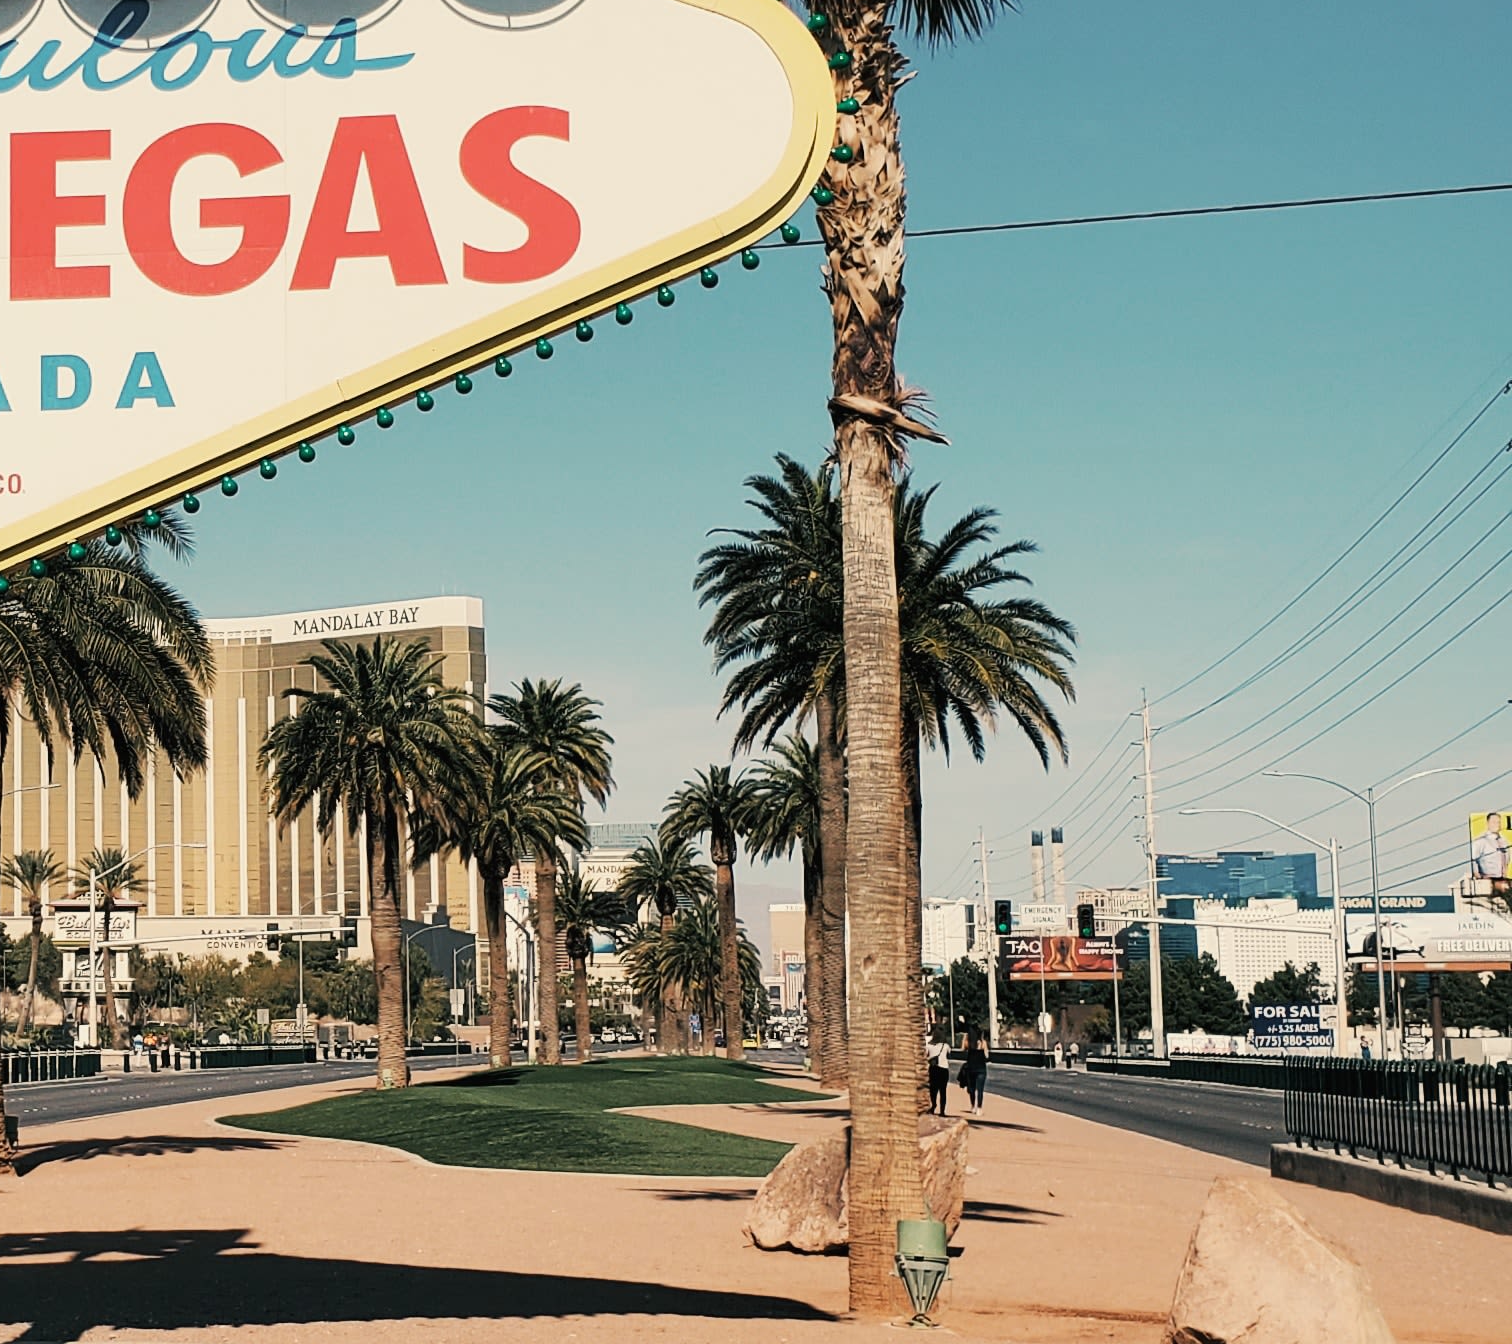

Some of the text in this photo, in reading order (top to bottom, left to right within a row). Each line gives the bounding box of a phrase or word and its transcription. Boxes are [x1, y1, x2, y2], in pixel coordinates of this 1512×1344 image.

[292, 606, 420, 635] MANDALAY BAY
[587, 865, 625, 874] MANDA
[1339, 897, 1426, 909] MGM GRAND
[1005, 940, 1041, 954] TAO
[1437, 940, 1464, 952] FREE
[1254, 1006, 1320, 1018] FOR SAL
[1254, 1036, 1281, 1048] (775)
